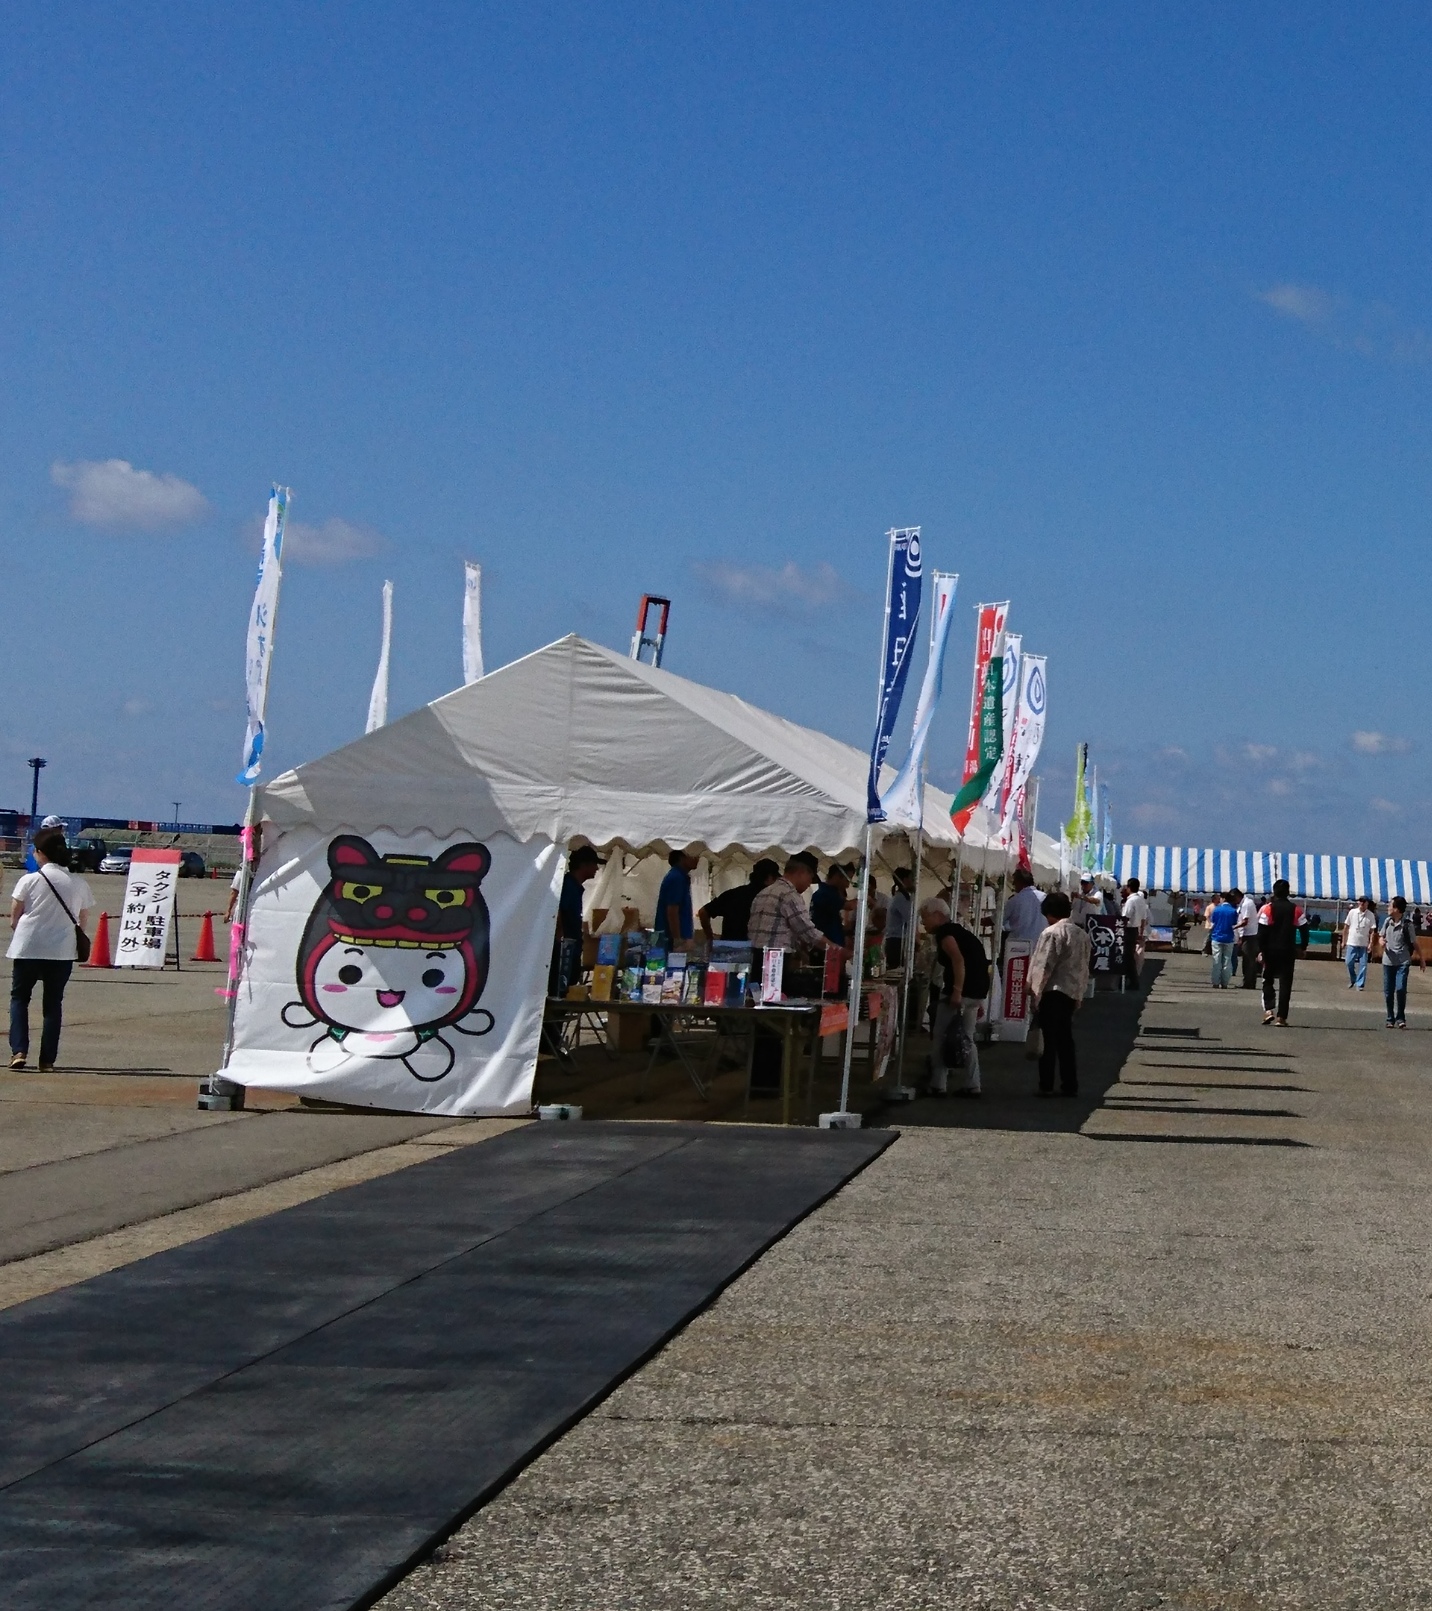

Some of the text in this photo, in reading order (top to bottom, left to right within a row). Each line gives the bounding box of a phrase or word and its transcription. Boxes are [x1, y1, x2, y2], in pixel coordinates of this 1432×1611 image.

[142, 870, 171, 950] タクシー駐車場
